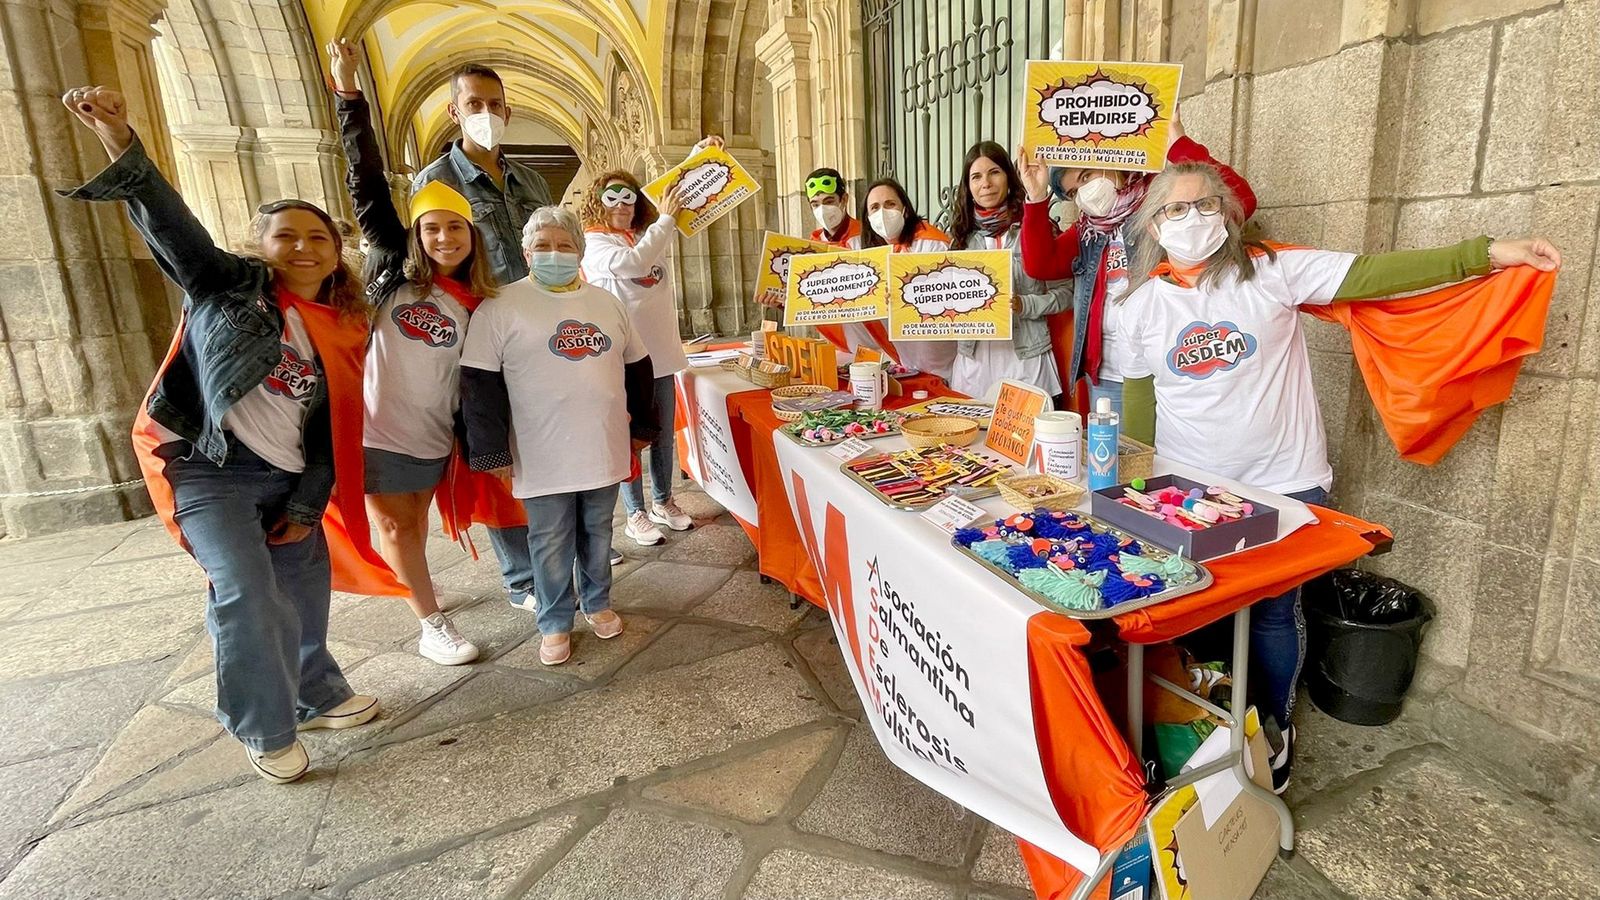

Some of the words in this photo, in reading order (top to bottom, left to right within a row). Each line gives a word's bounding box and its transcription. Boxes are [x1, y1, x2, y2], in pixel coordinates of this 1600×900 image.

[1056, 94, 1141, 109] PROHIBIDO
[1096, 154, 1146, 165] MÚLTIPLE
[698, 169, 726, 192] PODERES
[700, 167, 715, 180] CON
[806, 287, 829, 297] CADA
[831, 279, 873, 293] MOMENTO
[807, 277, 838, 288] SUPERO
[840, 272, 865, 283] RETOS
[866, 270, 873, 278] A
[913, 282, 958, 294] PERSONA
[959, 279, 982, 289] CON
[914, 294, 944, 305] SÚPER
[945, 290, 988, 301] PODERES
[398, 310, 453, 342] ASDEM
[902, 328, 951, 336] ESCLEROSIS
[557, 336, 605, 349] ASDEM
[1184, 330, 1220, 347] súper
[1177, 337, 1246, 368] ASDEM
[866, 554, 970, 692] Asociación
[868, 614, 889, 659] De
[868, 586, 976, 731] Salmantina
[867, 643, 970, 776] Esclerosis
